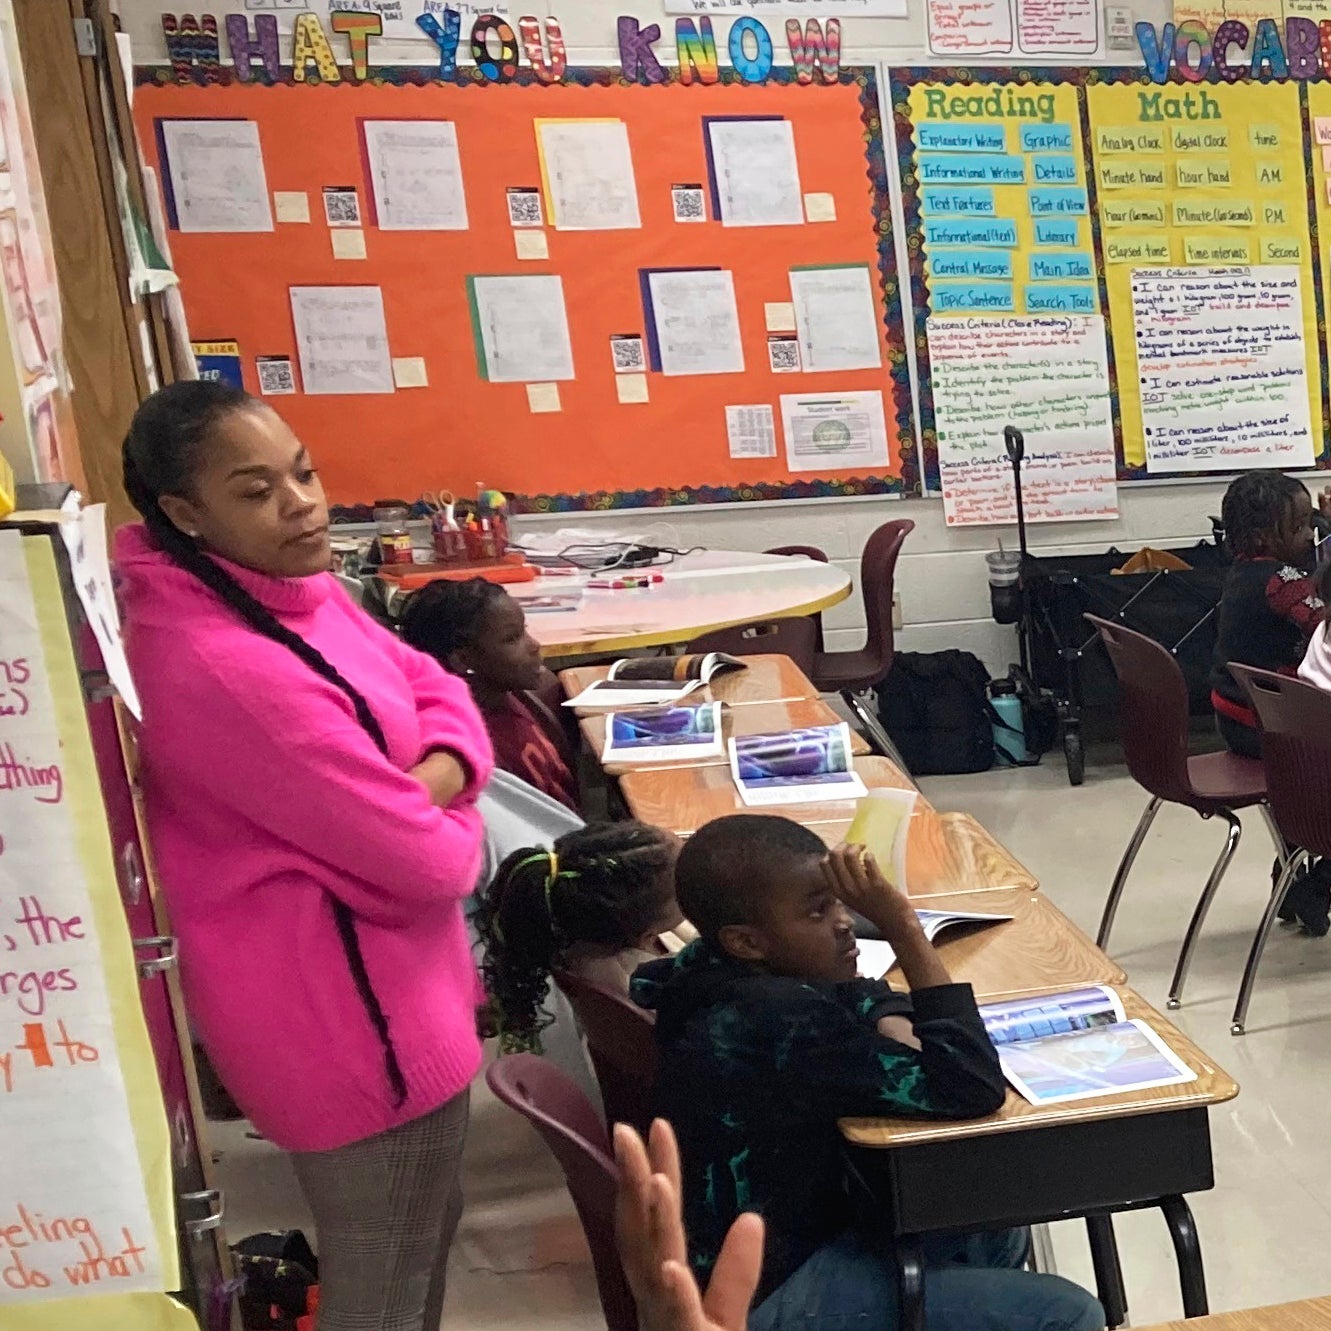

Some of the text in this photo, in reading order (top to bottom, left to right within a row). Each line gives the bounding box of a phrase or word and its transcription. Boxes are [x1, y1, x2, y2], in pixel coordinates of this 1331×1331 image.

[161, 11, 383, 83] WHAT
[415, 9, 568, 82] YOU
[616, 15, 843, 85] KNOW
[924, 88, 1055, 123] Reading
[1138, 91, 1222, 121] Math
[1024, 132, 1071, 151] Graphic
[1101, 135, 1135, 150] Analog
[1254, 133, 1278, 146] time
[990, 165, 1024, 181] Writing
[1034, 164, 1075, 180] Details
[1102, 169, 1163, 183] Minute hand
[1179, 166, 1229, 182] hour hand
[1145, 244, 1168, 258] time
[1188, 245, 1209, 260] time
[1267, 243, 1300, 258] Second
[932, 259, 969, 275] Central
[1034, 261, 1090, 277] Main Idea
[937, 290, 1012, 307] Topic Sentence
[1028, 294, 1094, 310] Search Tools
[15, 895, 85, 946] the
[54, 1018, 99, 1066] to
[3, 1250, 52, 1289] do
